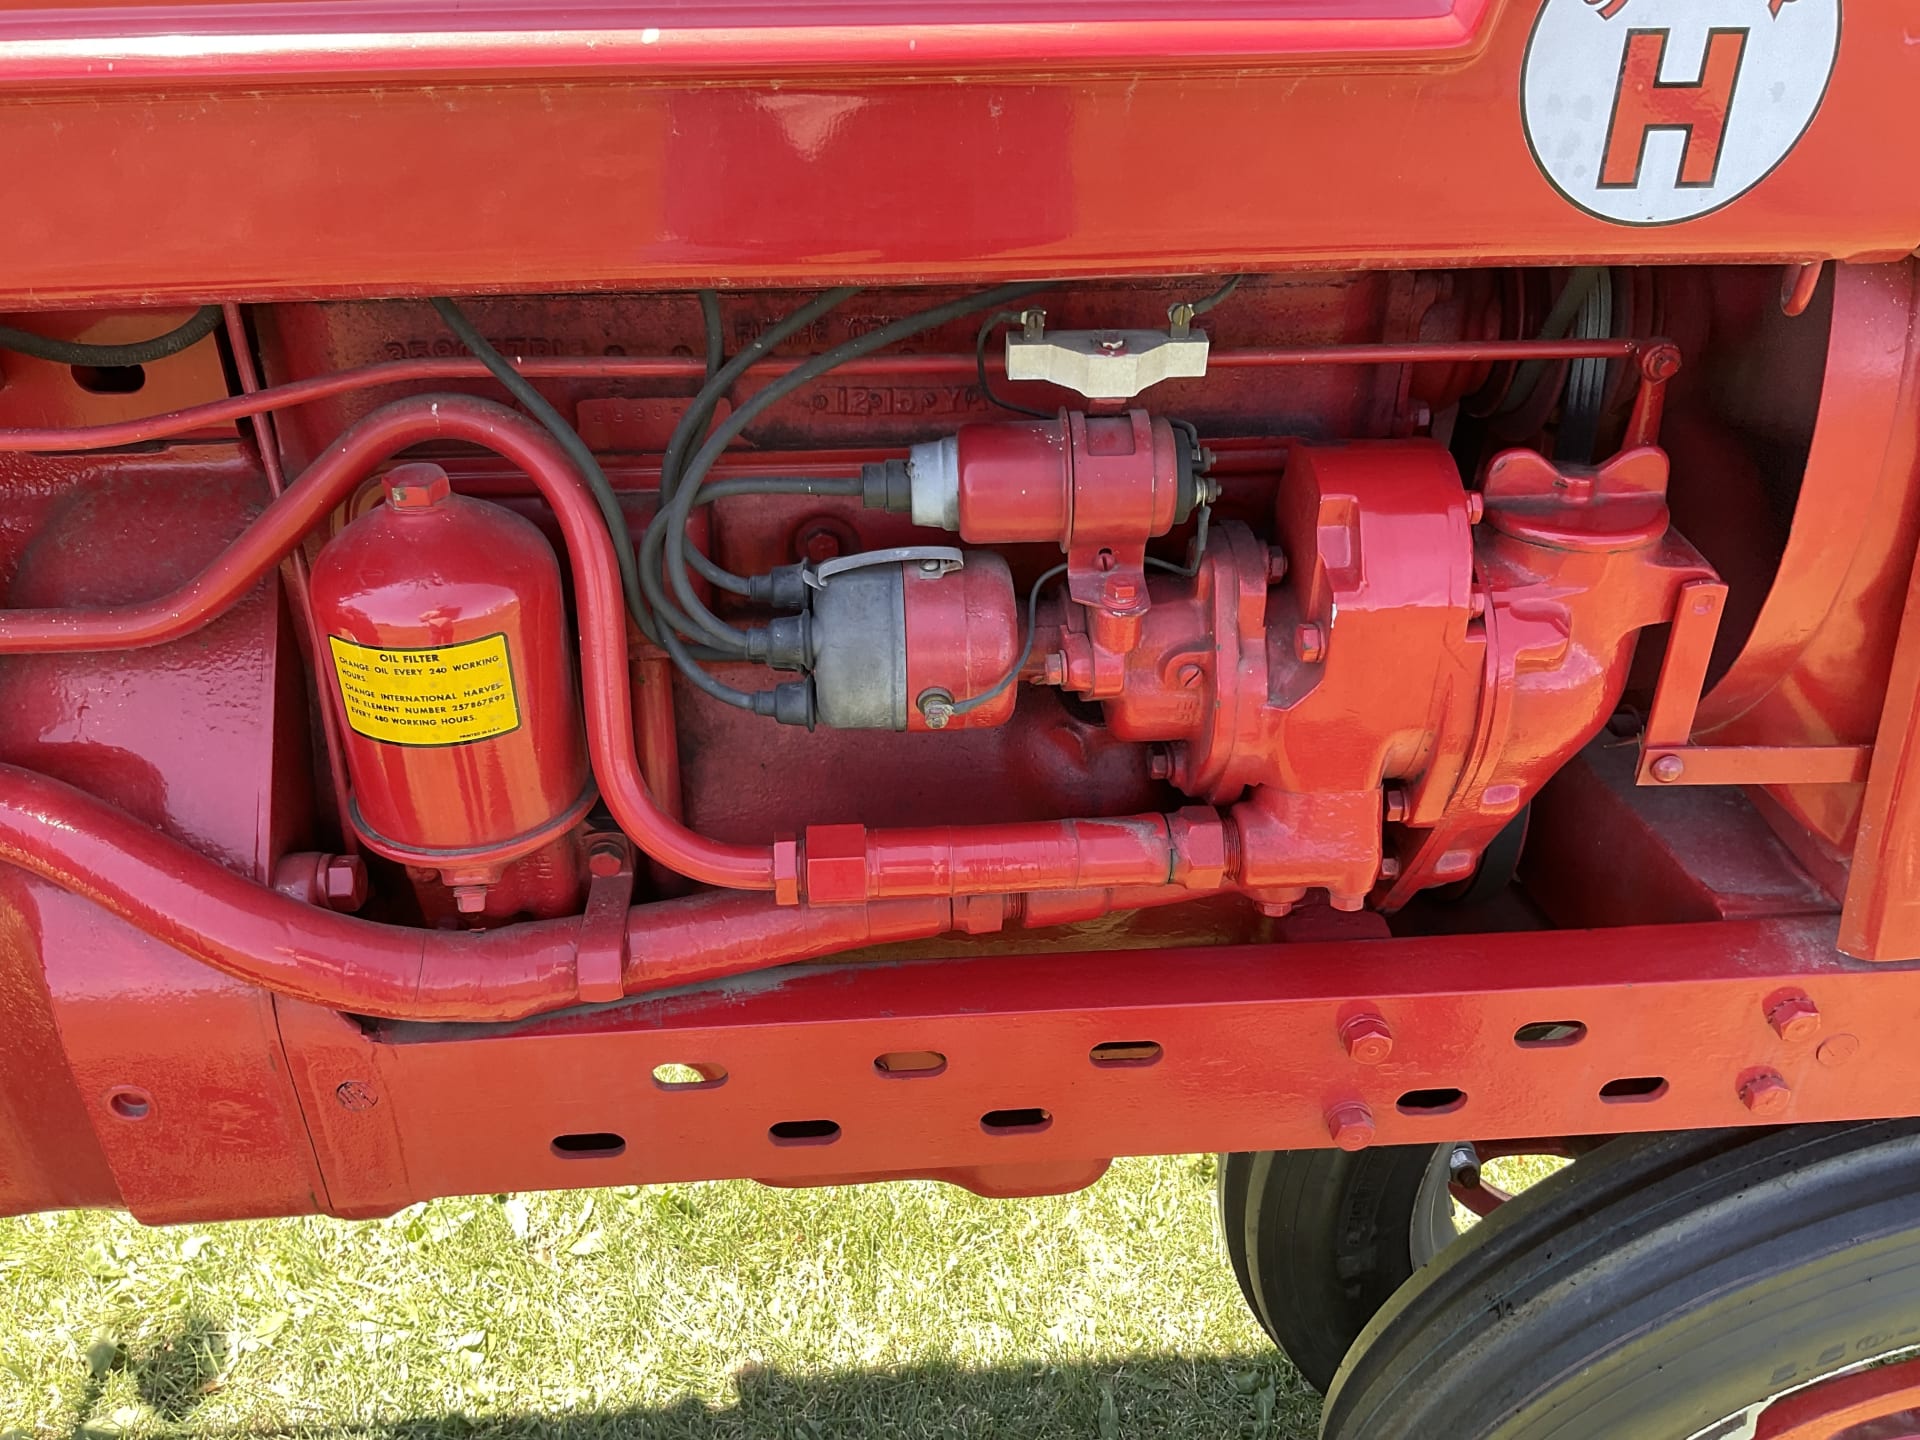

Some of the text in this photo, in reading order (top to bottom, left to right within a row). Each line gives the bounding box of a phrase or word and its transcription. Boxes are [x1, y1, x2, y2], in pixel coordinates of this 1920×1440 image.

[1597, 27, 1750, 189] H
[339, 655, 500, 676] CHANGE OIL EVERY 240 WORKING
[379, 654, 440, 664] OIL FILTER
[345, 682, 504, 703] CHANGE INTERNATIONAL HARVES-
[347, 693, 505, 715] TER ELEMENT NUMBER 257867R92
[351, 706, 371, 719] EVERY
[391, 717, 437, 726] WORKING
